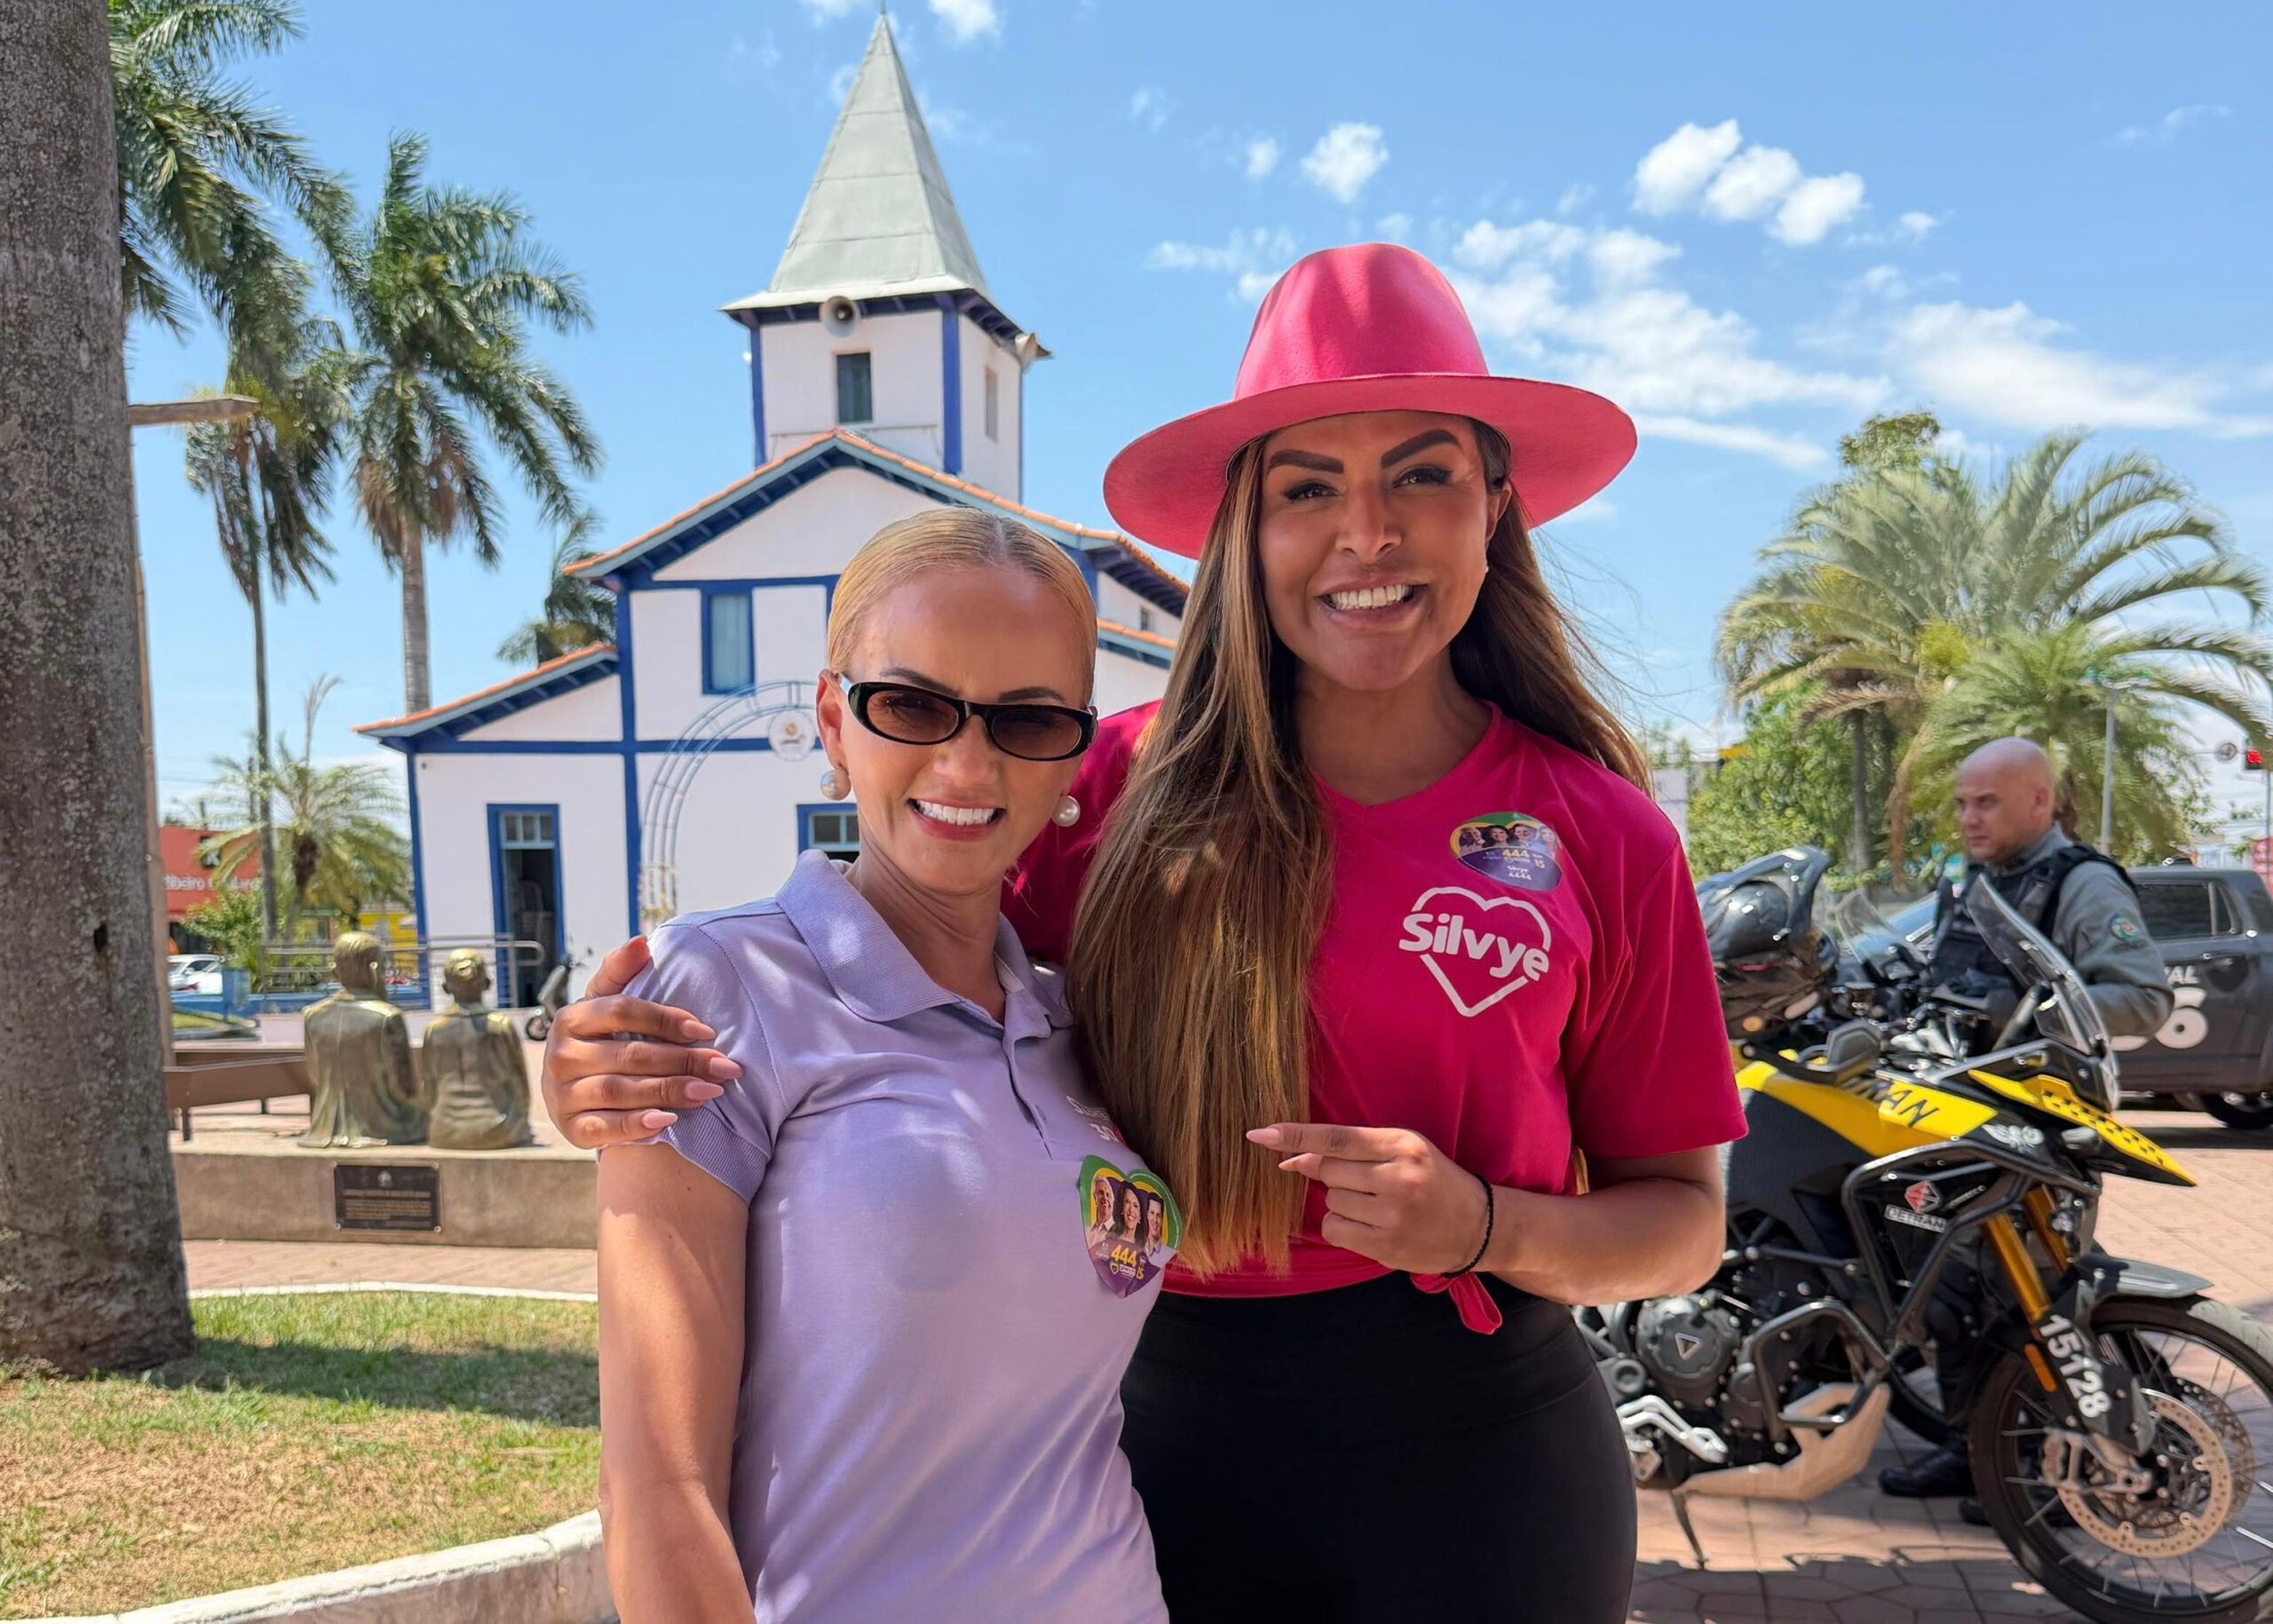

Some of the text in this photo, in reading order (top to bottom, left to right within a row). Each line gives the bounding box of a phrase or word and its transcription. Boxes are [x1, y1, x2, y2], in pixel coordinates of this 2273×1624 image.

[1502, 849, 1531, 859] 444
[1398, 913, 1549, 981] Silvye
[1111, 1244, 1137, 1267] 444
[2039, 1314, 2112, 1418] 15128
